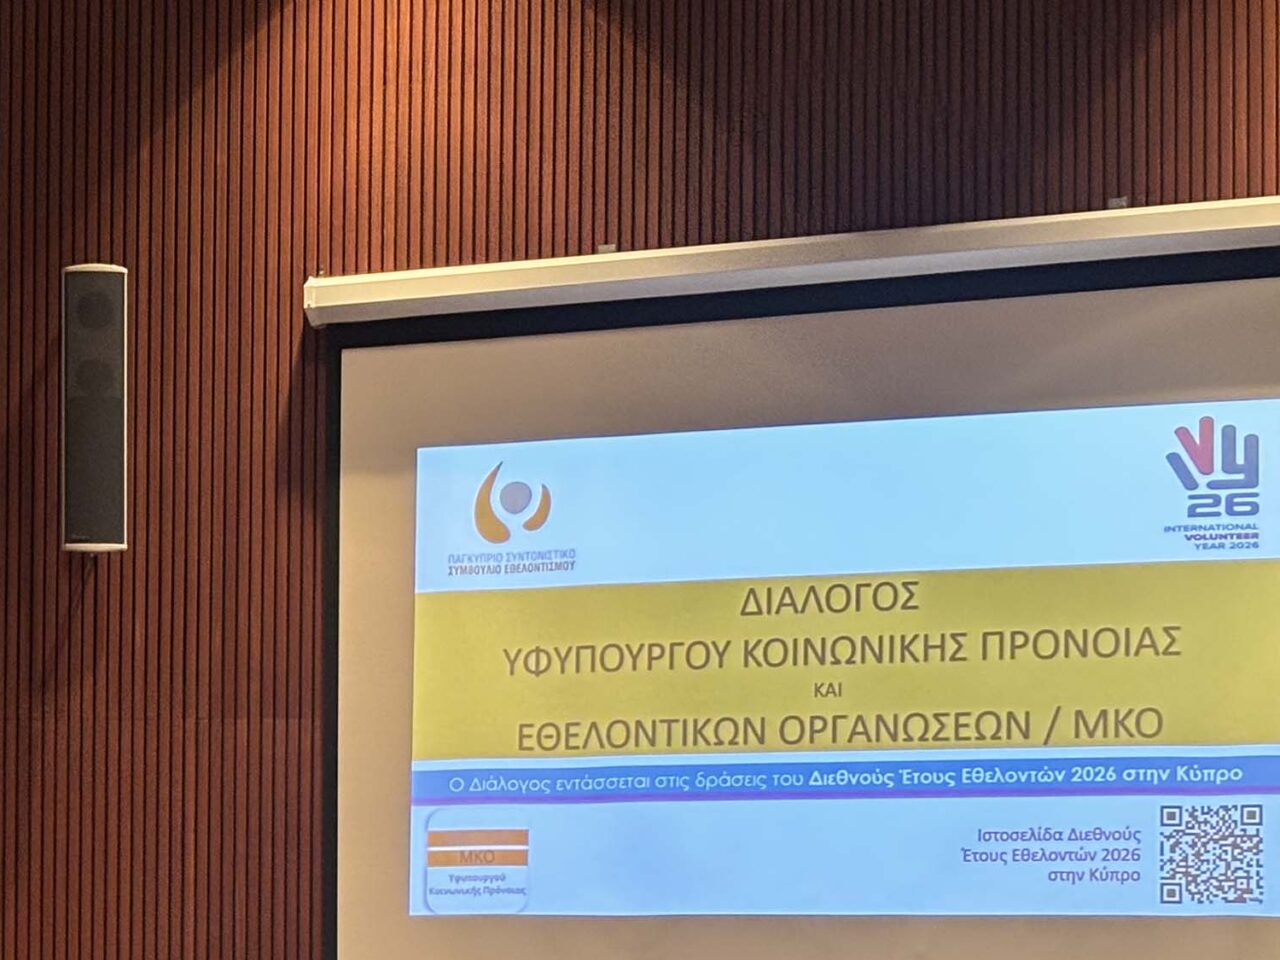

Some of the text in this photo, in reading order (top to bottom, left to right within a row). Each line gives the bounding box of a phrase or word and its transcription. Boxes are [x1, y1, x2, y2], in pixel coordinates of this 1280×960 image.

[1187, 492, 1260, 518] 26
[1163, 523, 1259, 533] INTERNATIONAL
[1184, 532, 1259, 541] VOLUNTEER
[1195, 541, 1260, 550] YEAR 2026
[448, 548, 577, 565] ΠΑΓΚΥΠΡΙΟ ΣΥΝΤΟΝΙΣΤΙΚΟ
[448, 560, 576, 577] ΣΥΜΒΟΥΛΙΟ ΕΘΕΛΟΝΤΙΣΜΟΥ
[740, 581, 920, 616] ΔΙΑΛΟΓΟΣ
[503, 626, 1182, 678] ΥΦΥΠΟΥΡΓΟΥ ΚΟΙΝΩΝΙΚΗΣ ΠΡΟΝΟΙΑΣ
[814, 682, 843, 698] ΚΑΙ
[519, 706, 1164, 752] ΕΘΕΛΟΝΤΙΚΩΝ ΟΡΓΑΝΩΣΕΩΝ / ΜΚΟ
[448, 764, 1243, 794] Ο Διάλογος εντάσσεται στις δράσεις του Διεθνούς Έτους Εθελοντών 2026 στην Κύπρο
[977, 826, 1142, 844] Ιστοσελίδα Διεθνούς
[459, 851, 496, 864] ΜΚΟ
[961, 847, 1141, 866] Έτους Εθελοντών 2026
[1048, 866, 1141, 885] στην Κύπρο
